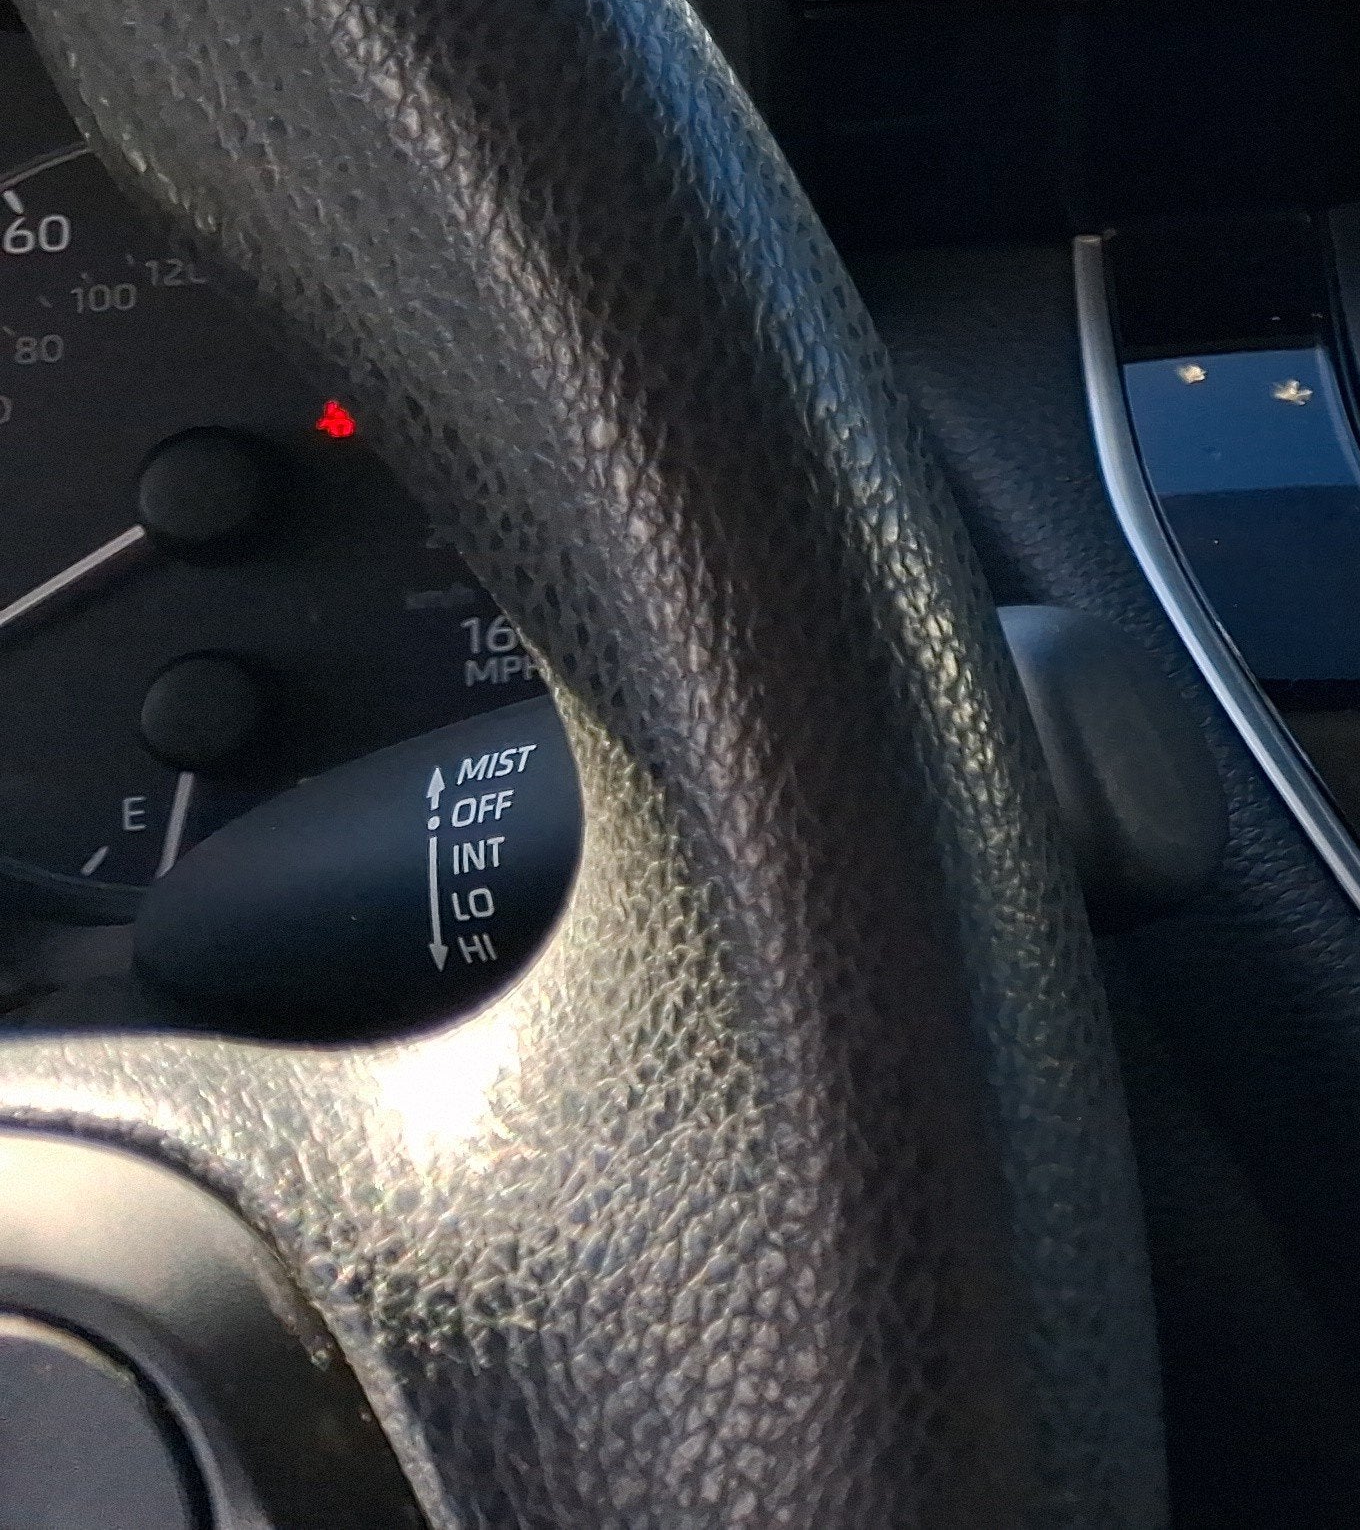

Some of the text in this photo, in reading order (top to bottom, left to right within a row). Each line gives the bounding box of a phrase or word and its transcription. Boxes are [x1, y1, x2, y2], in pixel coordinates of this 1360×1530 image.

[3, 215, 71, 254] 60
[70, 283, 137, 313] 100
[14, 334, 64, 364] 80
[456, 744, 537, 785] MIST
[122, 796, 147, 831] E
[451, 789, 514, 828] OFF
[453, 836, 505, 875] INT
[452, 887, 495, 921] LO
[457, 932, 498, 964] HI
